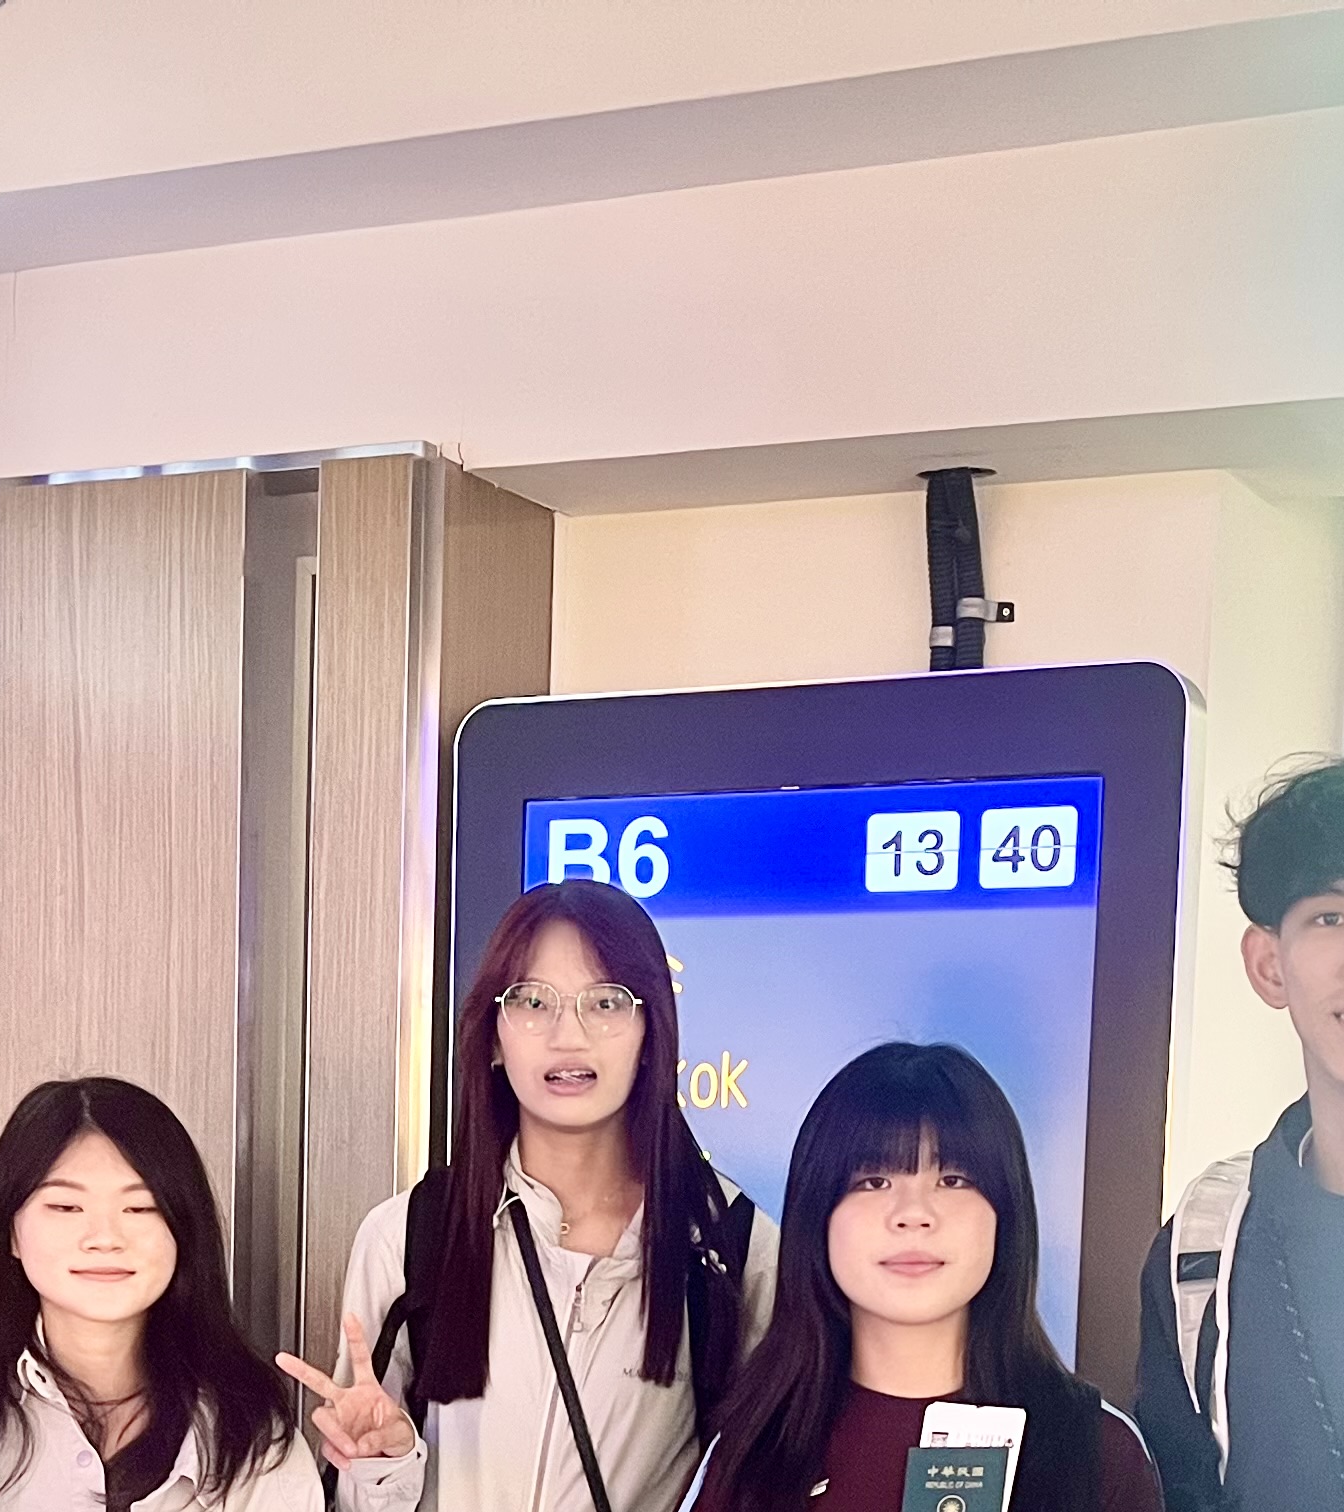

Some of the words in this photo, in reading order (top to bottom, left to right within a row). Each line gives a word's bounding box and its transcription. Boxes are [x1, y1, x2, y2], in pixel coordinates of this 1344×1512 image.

[547, 815, 671, 899] B6
[882, 829, 945, 877] 13
[990, 825, 1062, 873] 40
